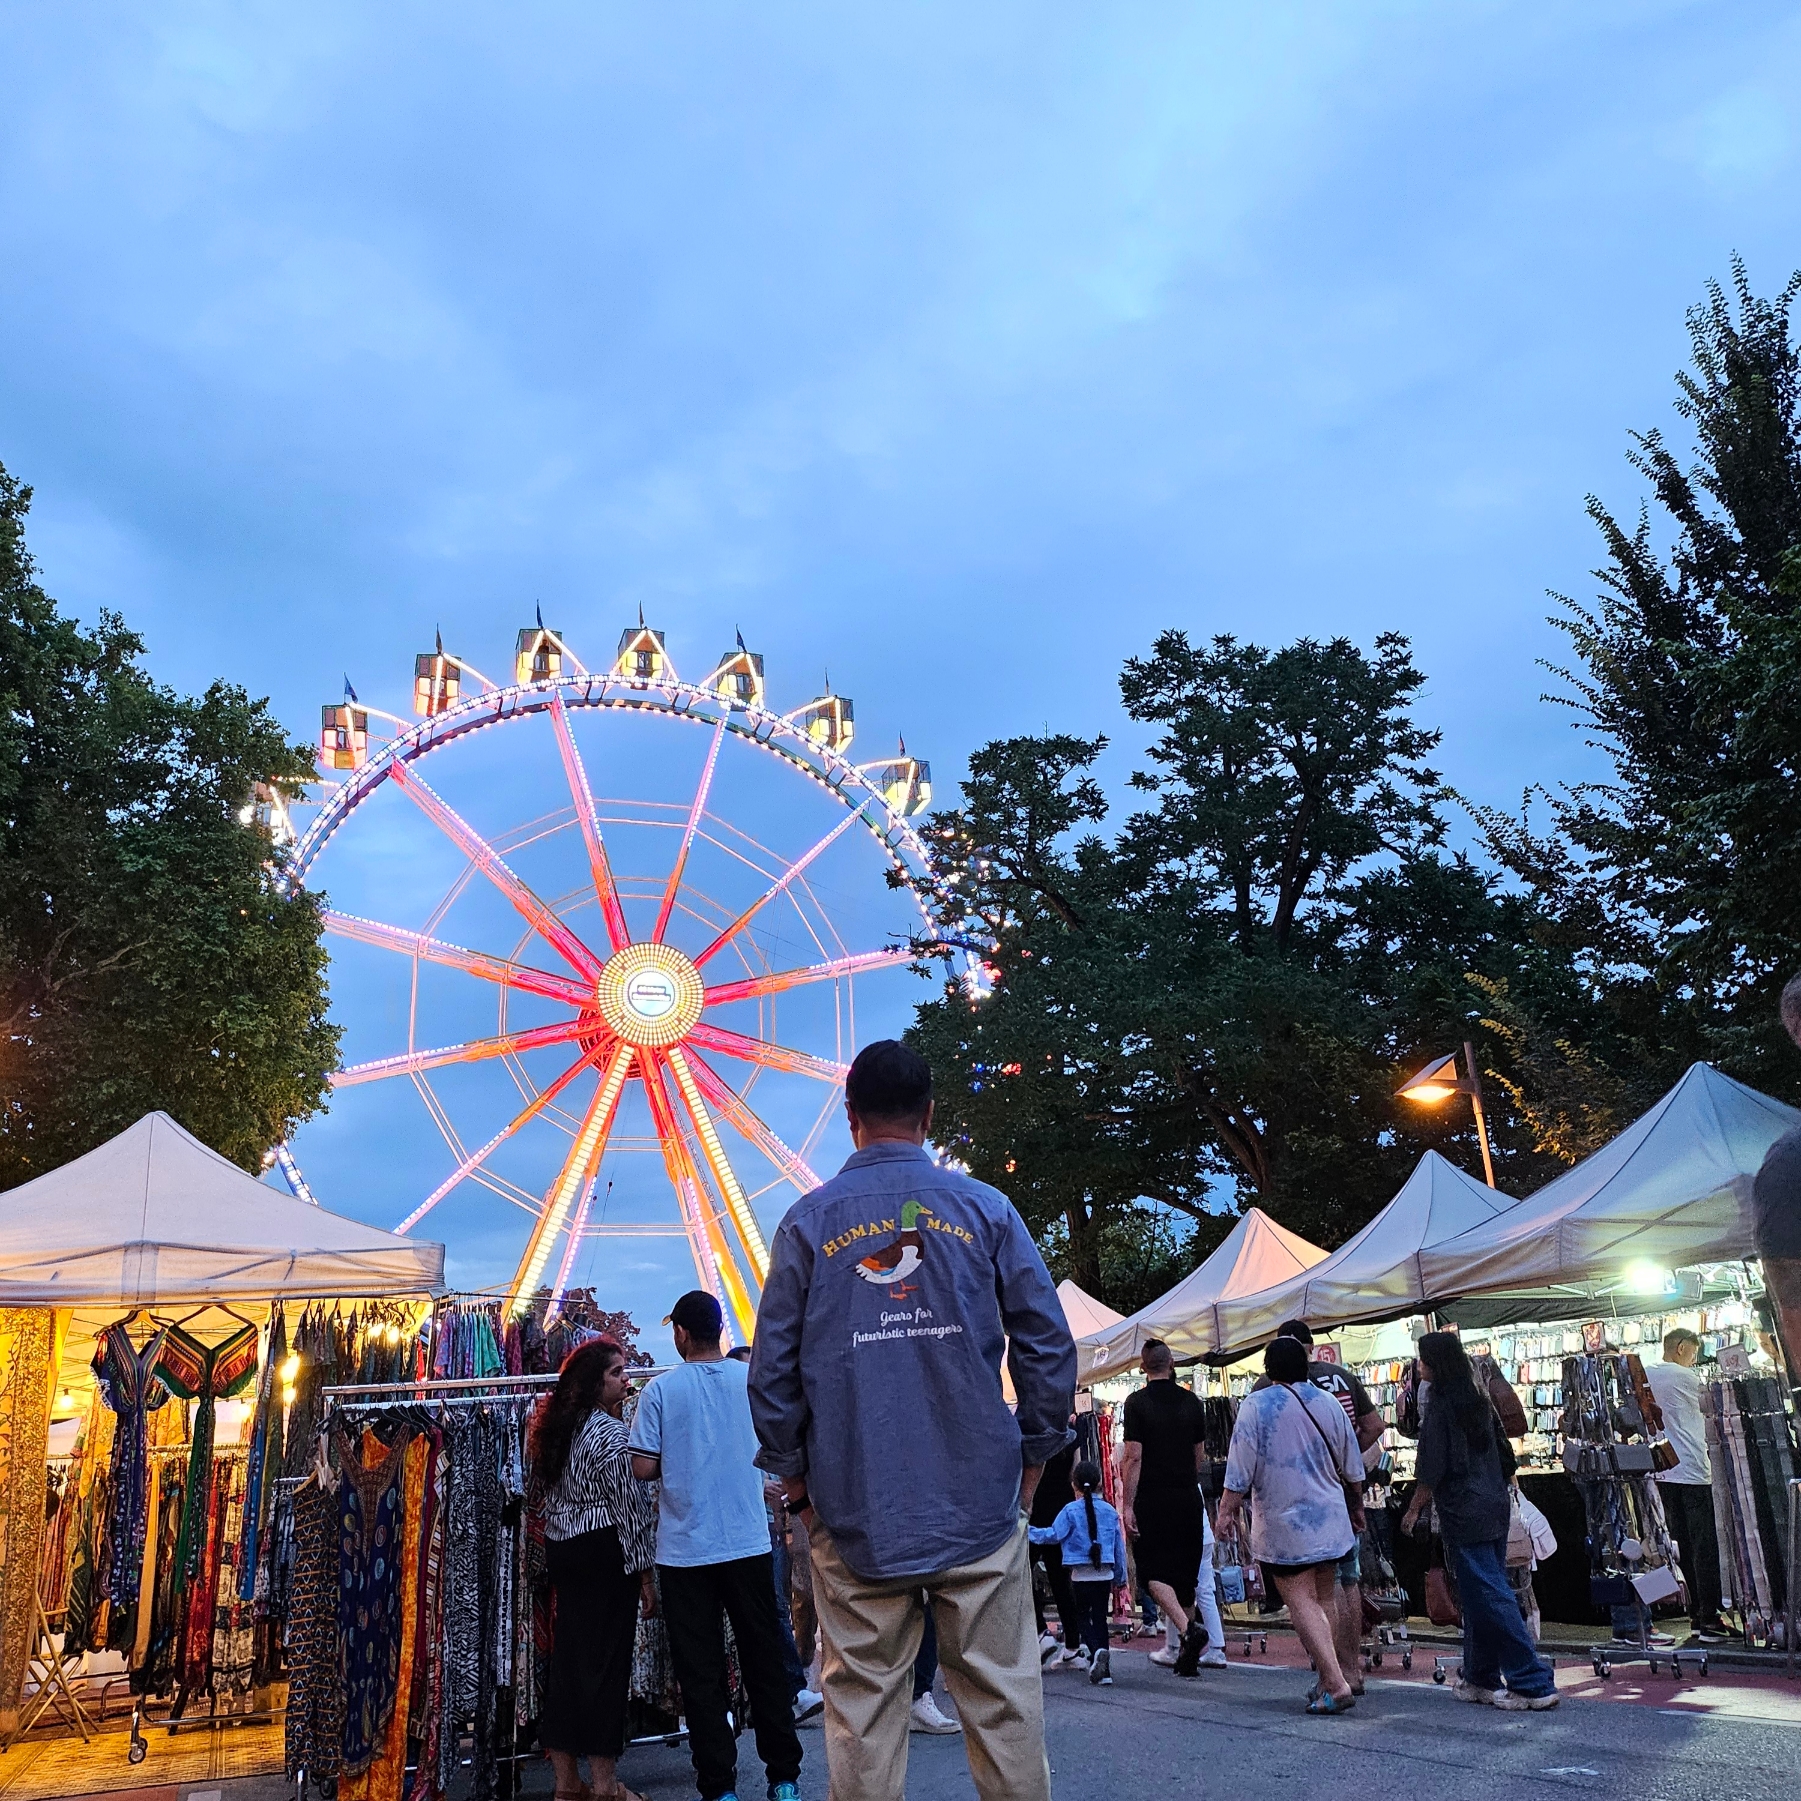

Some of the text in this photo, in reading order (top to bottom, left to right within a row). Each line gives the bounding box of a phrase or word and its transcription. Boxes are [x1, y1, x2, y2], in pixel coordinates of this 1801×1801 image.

[822, 1217, 974, 1258] HUMAN MADE
[880, 1307, 934, 1327] Gears for
[852, 1323, 963, 1348] futuristic teenagers
[1307, 1374, 1350, 1393] SA
